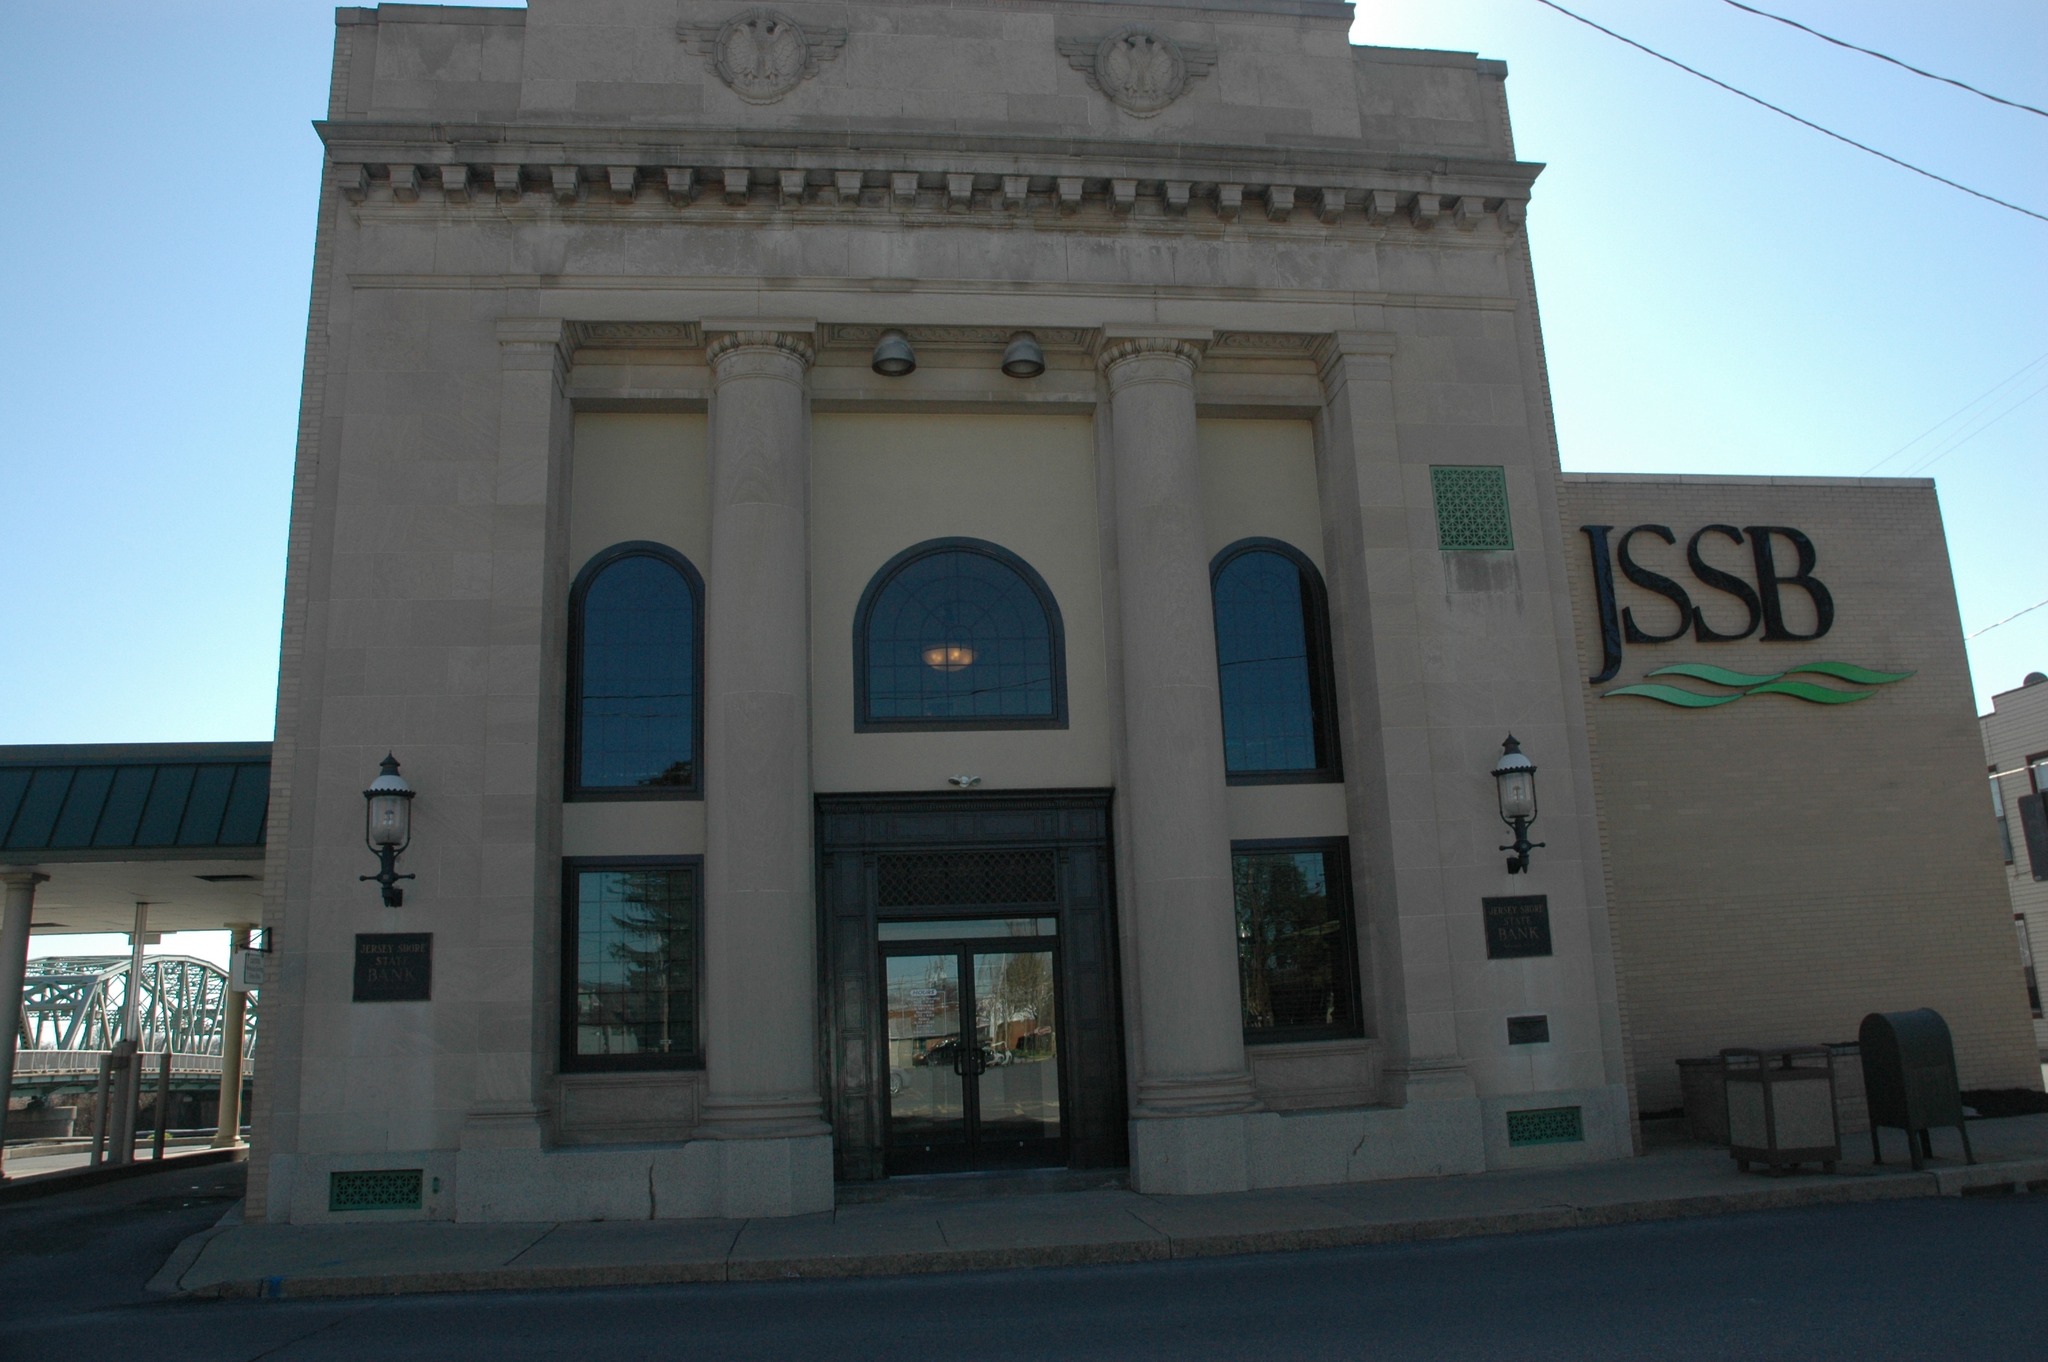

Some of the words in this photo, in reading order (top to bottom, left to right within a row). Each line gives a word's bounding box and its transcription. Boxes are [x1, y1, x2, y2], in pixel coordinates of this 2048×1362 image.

[1580, 524, 1834, 684] JSSB
[1489, 905, 1517, 916] JERSEY
[1520, 904, 1543, 914] SHORE
[1503, 916, 1530, 926] STATE
[1498, 926, 1539, 941] BANK
[360, 944, 394, 954] JERSEY
[398, 943, 425, 953] SHORE
[368, 968, 416, 983] BANK
